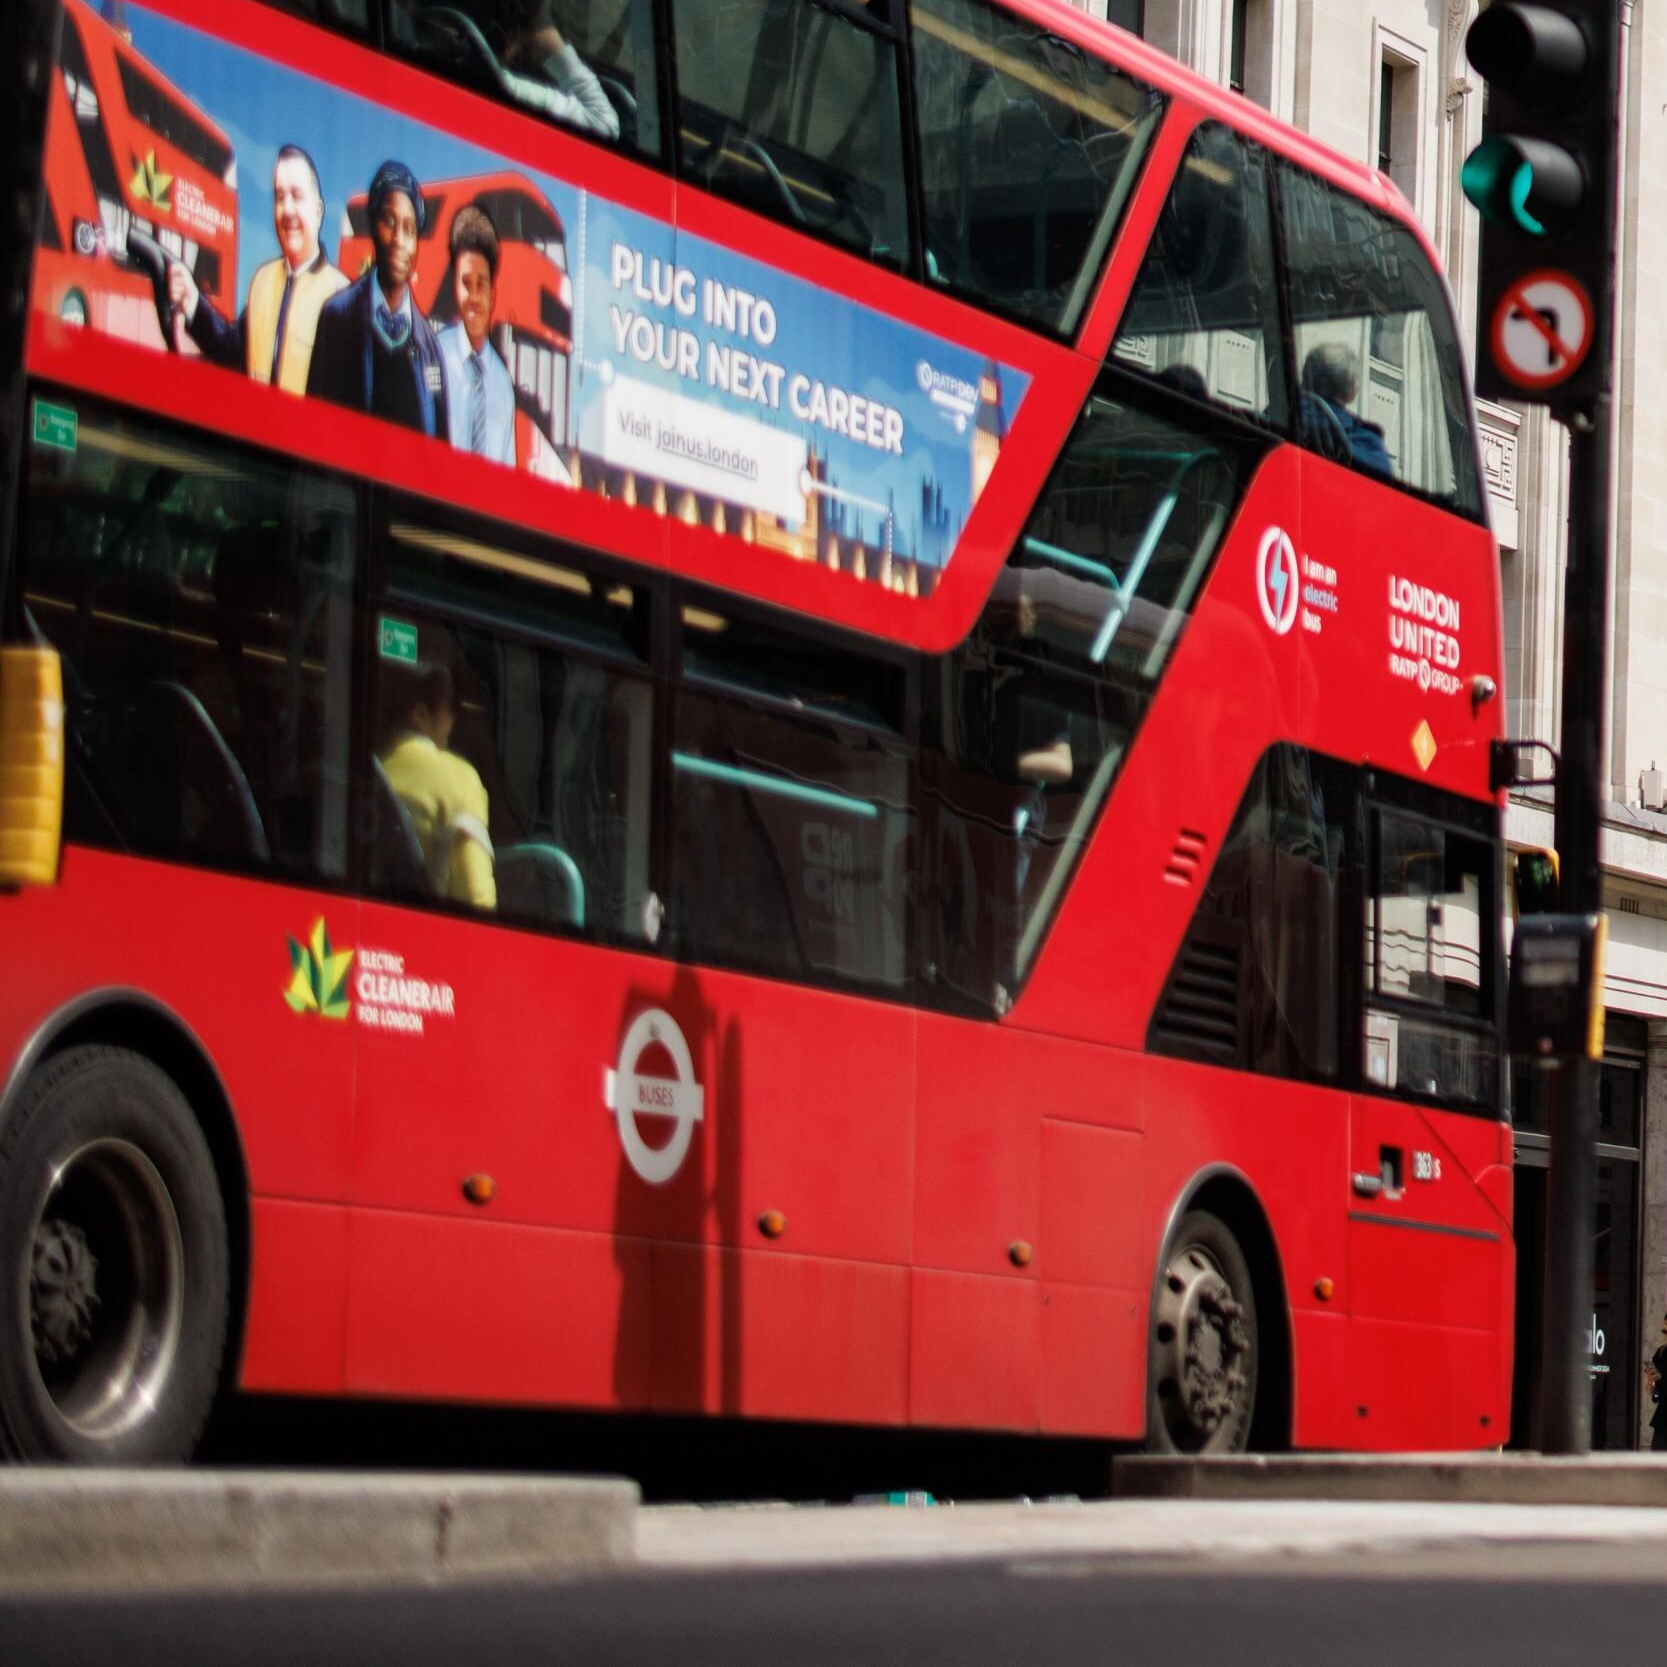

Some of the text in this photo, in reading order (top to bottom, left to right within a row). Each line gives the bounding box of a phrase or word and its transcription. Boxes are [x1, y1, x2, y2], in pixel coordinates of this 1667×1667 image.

[611, 243, 777, 346] PLUG INTO
[609, 305, 904, 456] YOUR NEXT CAREER
[618, 410, 759, 477] Visit joinus.london
[1303, 554, 1337, 585] I am an
[1303, 584, 1338, 613] electric
[1388, 573, 1460, 631] LONDON
[1302, 607, 1322, 634] bus
[1388, 614, 1460, 670] UNITED
[1388, 653, 1460, 696] RATP GROUP
[357, 948, 406, 976] ELECTRIC
[357, 1004, 424, 1034] FOR LONDON
[637, 1083, 675, 1108] BUSES
